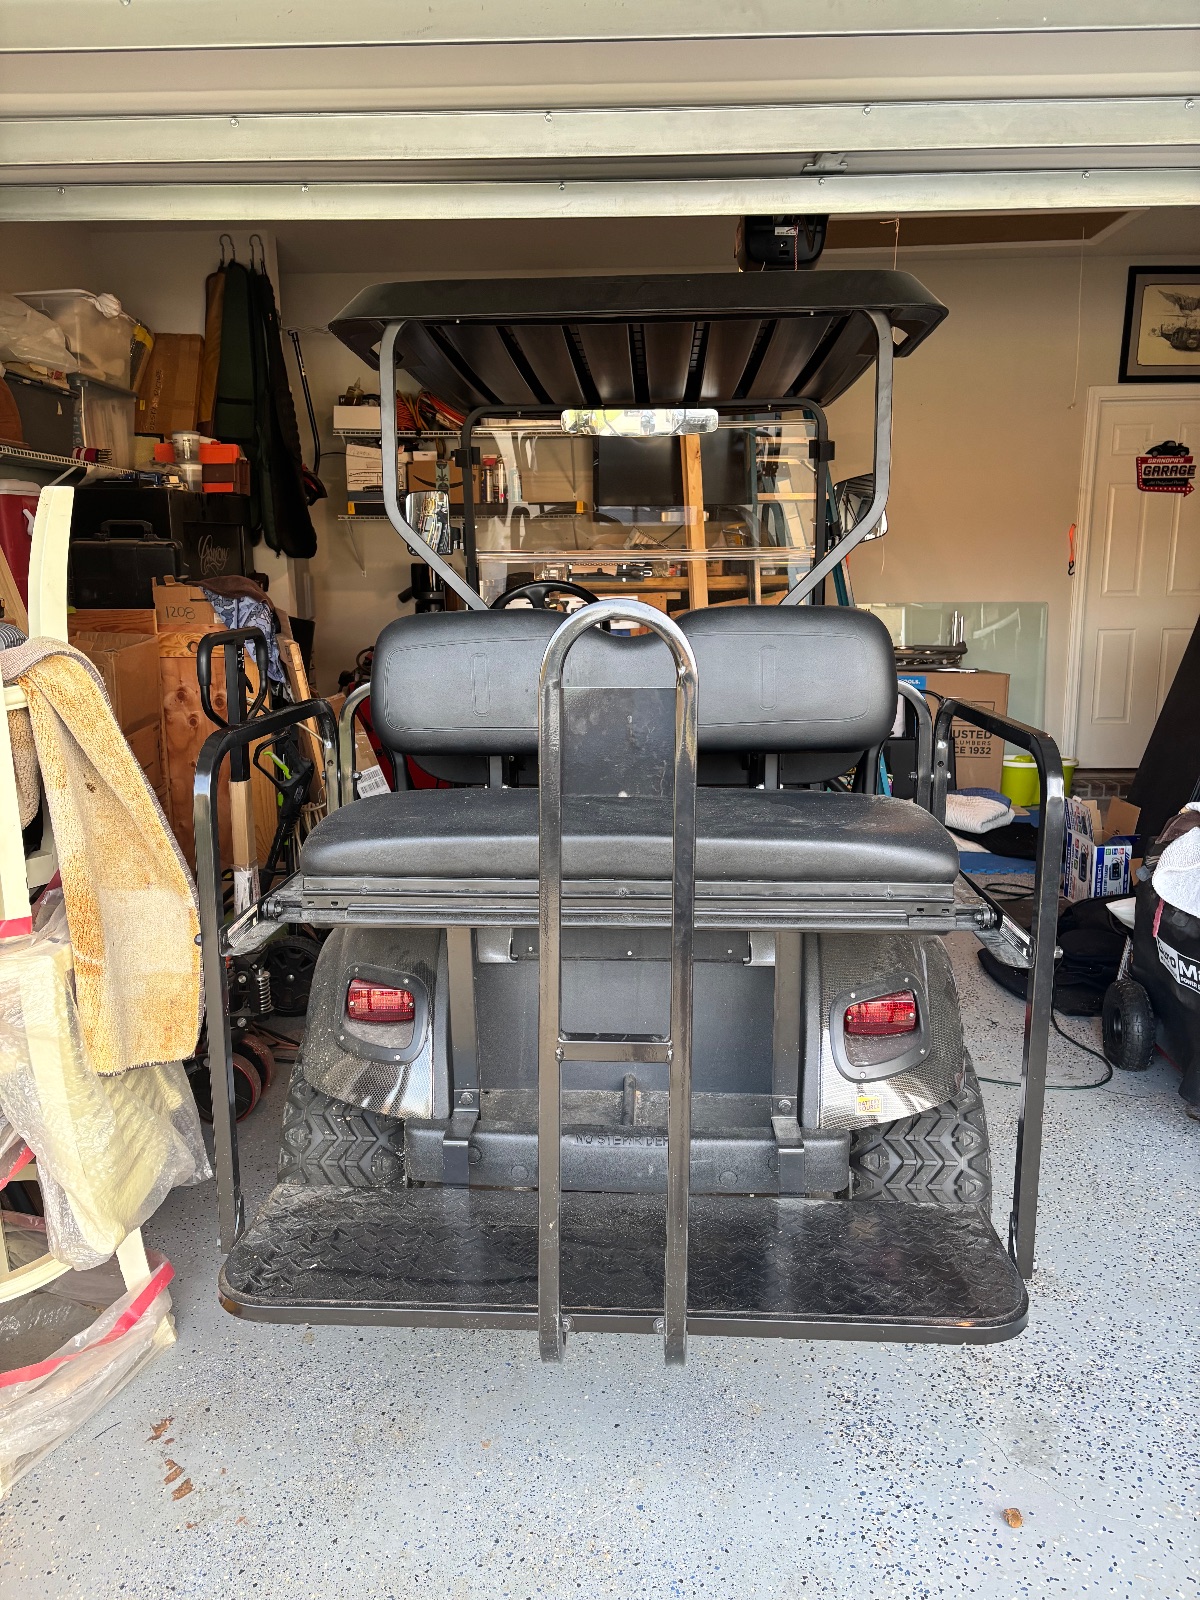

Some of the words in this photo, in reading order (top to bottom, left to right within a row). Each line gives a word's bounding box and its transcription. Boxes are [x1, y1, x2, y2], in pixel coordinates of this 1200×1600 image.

[1143, 465, 1197, 477] GARAGE
[166, 606, 196, 620] 1208
[953, 730, 992, 739] USTED
[969, 747, 992, 755] 1932
